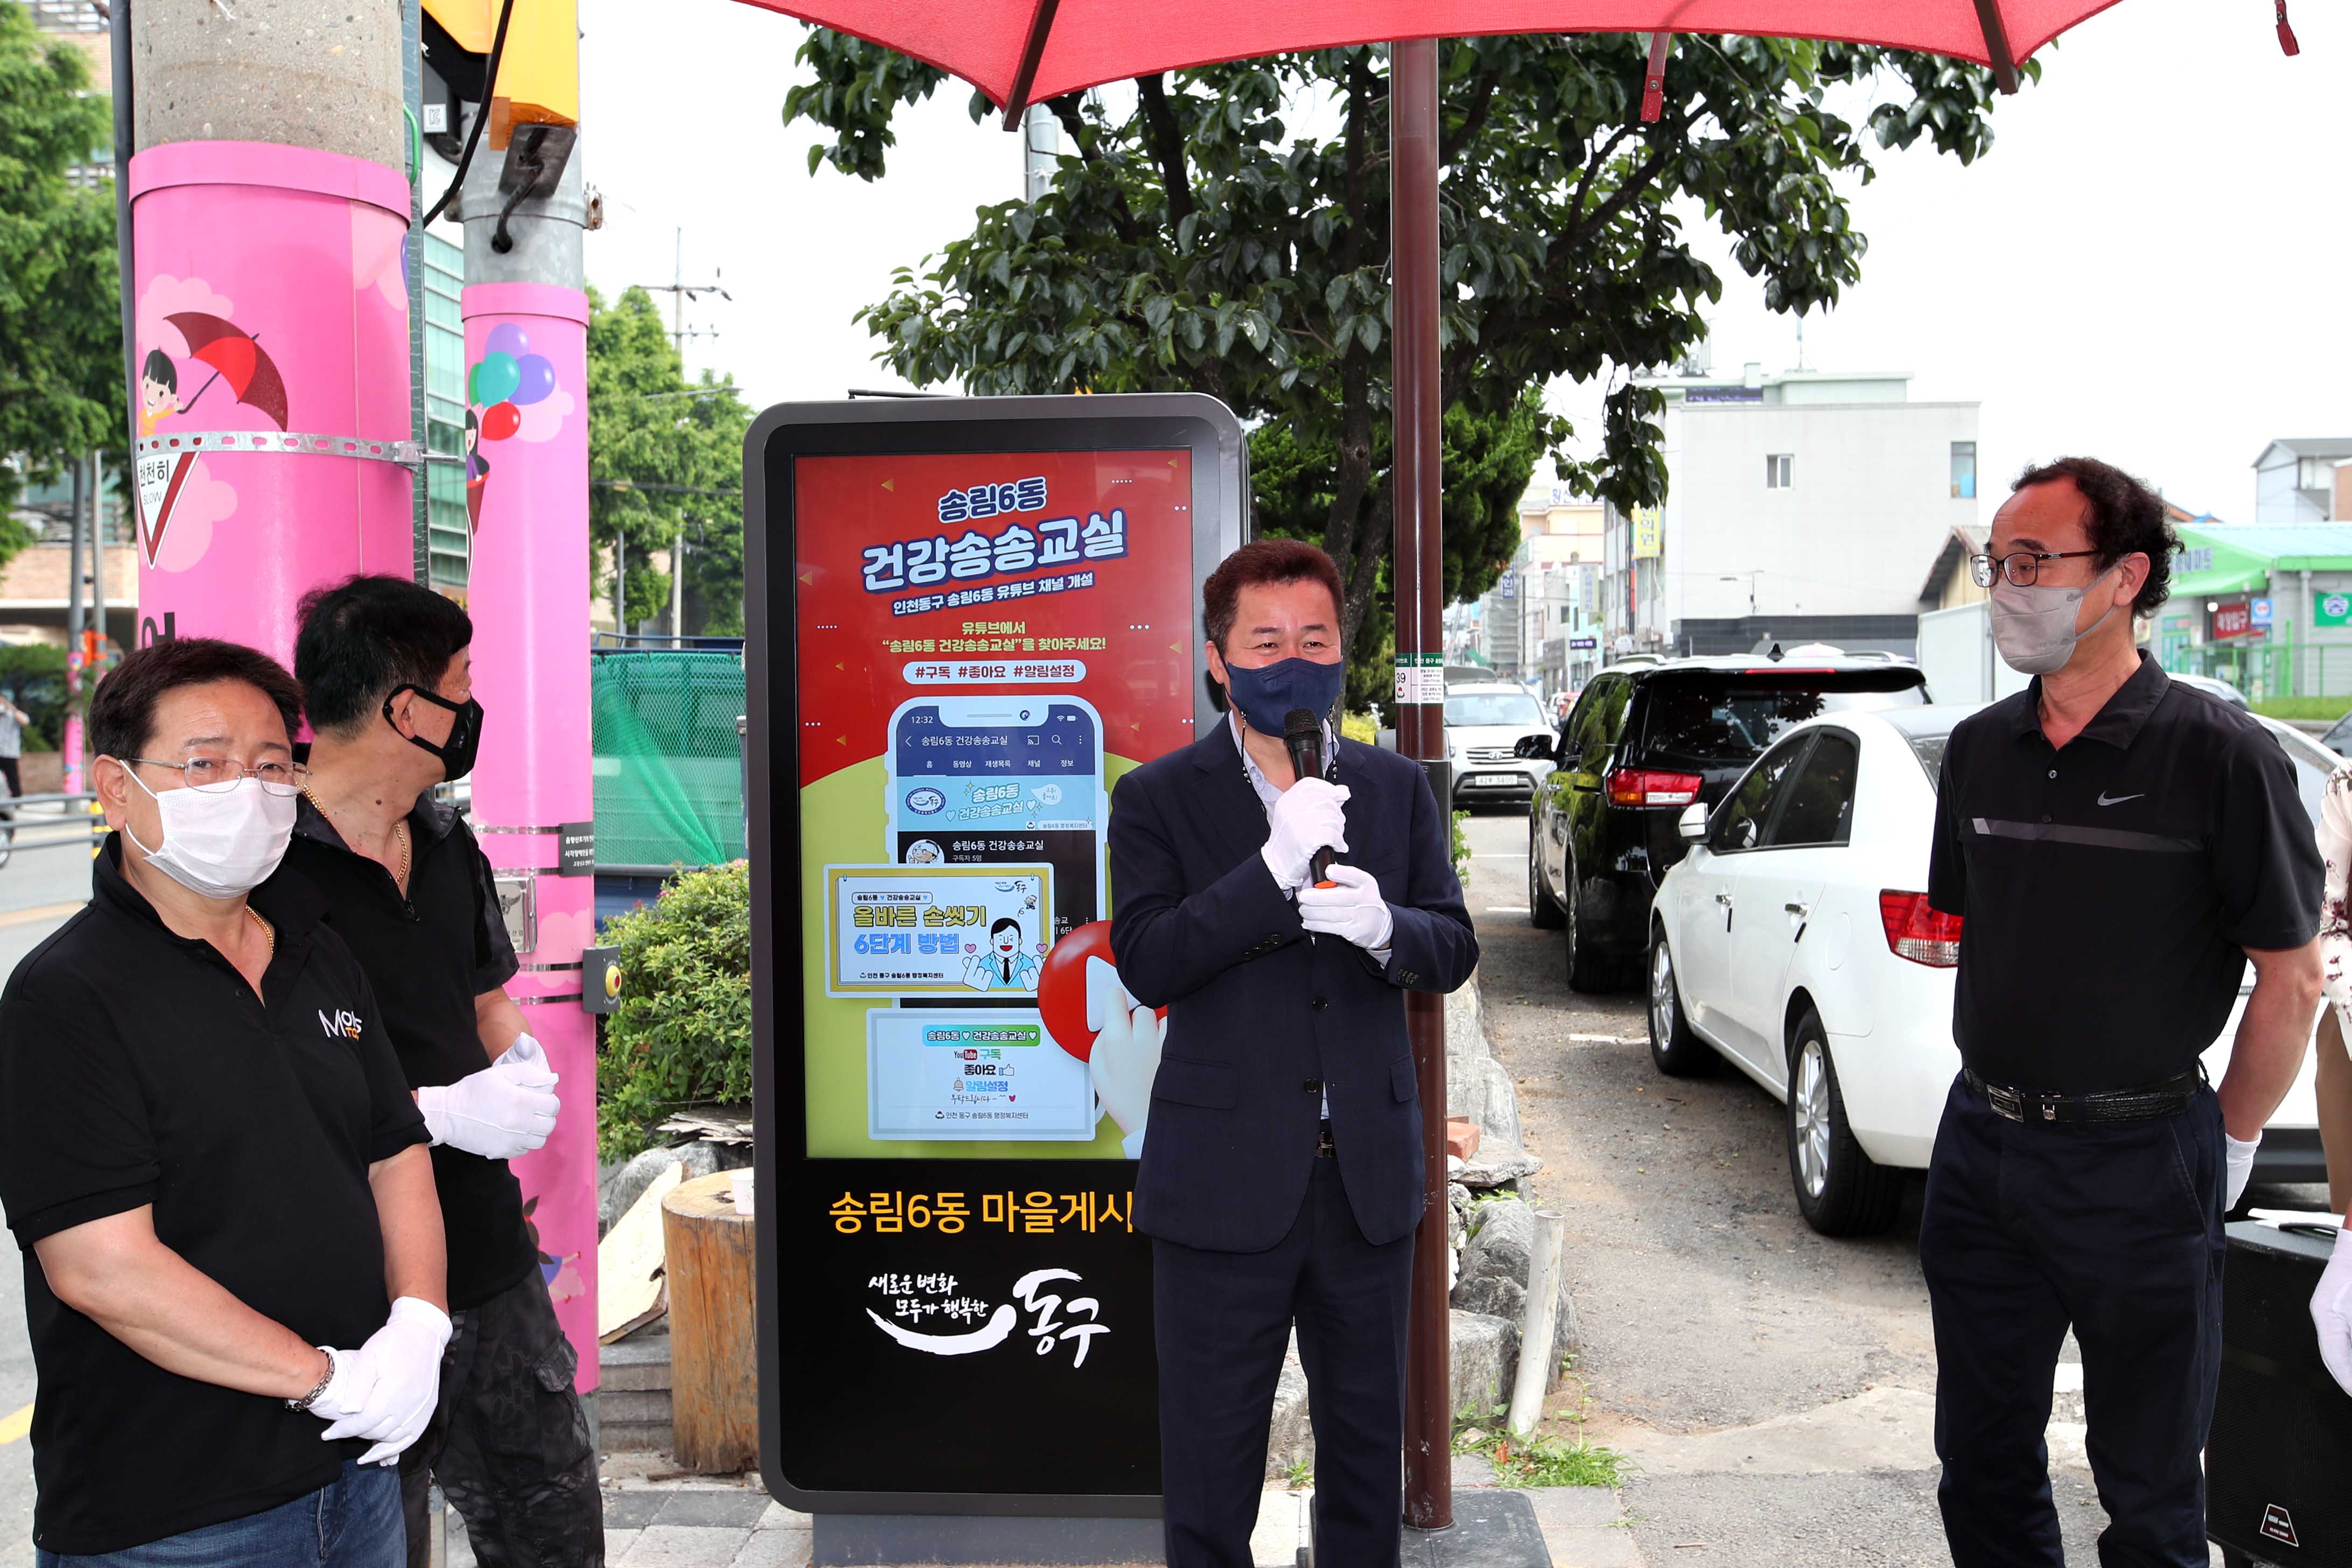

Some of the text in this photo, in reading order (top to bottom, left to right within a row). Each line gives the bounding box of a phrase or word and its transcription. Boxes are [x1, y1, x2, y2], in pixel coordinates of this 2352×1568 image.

[143, 491, 162, 505] SLOW
[938, 477, 1047, 523] 송림6동
[863, 509, 1126, 592] 건강송송교실
[893, 572, 1093, 614] 인천동구 송림6동 유튜브 채널 개설
[962, 621, 1026, 635] 유튜브에서
[1038, 638, 1107, 650] 찾아주세요!
[915, 665, 1075, 678] #구독 #좋아요 #알림설정
[1396, 673, 1406, 683] 39
[921, 735, 1008, 746] 송림6동 건강송송교실
[926, 759, 1074, 768] 홈 동영상 재생목록 채널 정보
[972, 783, 1019, 803] 송림6동
[958, 801, 1024, 821] 건강송송교실
[953, 840, 1044, 851] 송림6동 건강송송교실
[853, 905, 986, 927] 올바른 손씻기
[854, 933, 960, 954] 6단계 방법
[927, 1031, 1027, 1041] 송림6동 건강송송교실
[954, 1049, 1001, 1060] YouTube 구독
[964, 1064, 996, 1075] 좋아요
[965, 1081, 1008, 1092] 알림설정
[829, 1191, 1133, 1234] 송림6동 마을게시
[868, 1272, 958, 1296] 새로운 변화
[895, 1299, 989, 1324] 모두가 행복한
[1013, 1268, 1111, 1368] 동구
